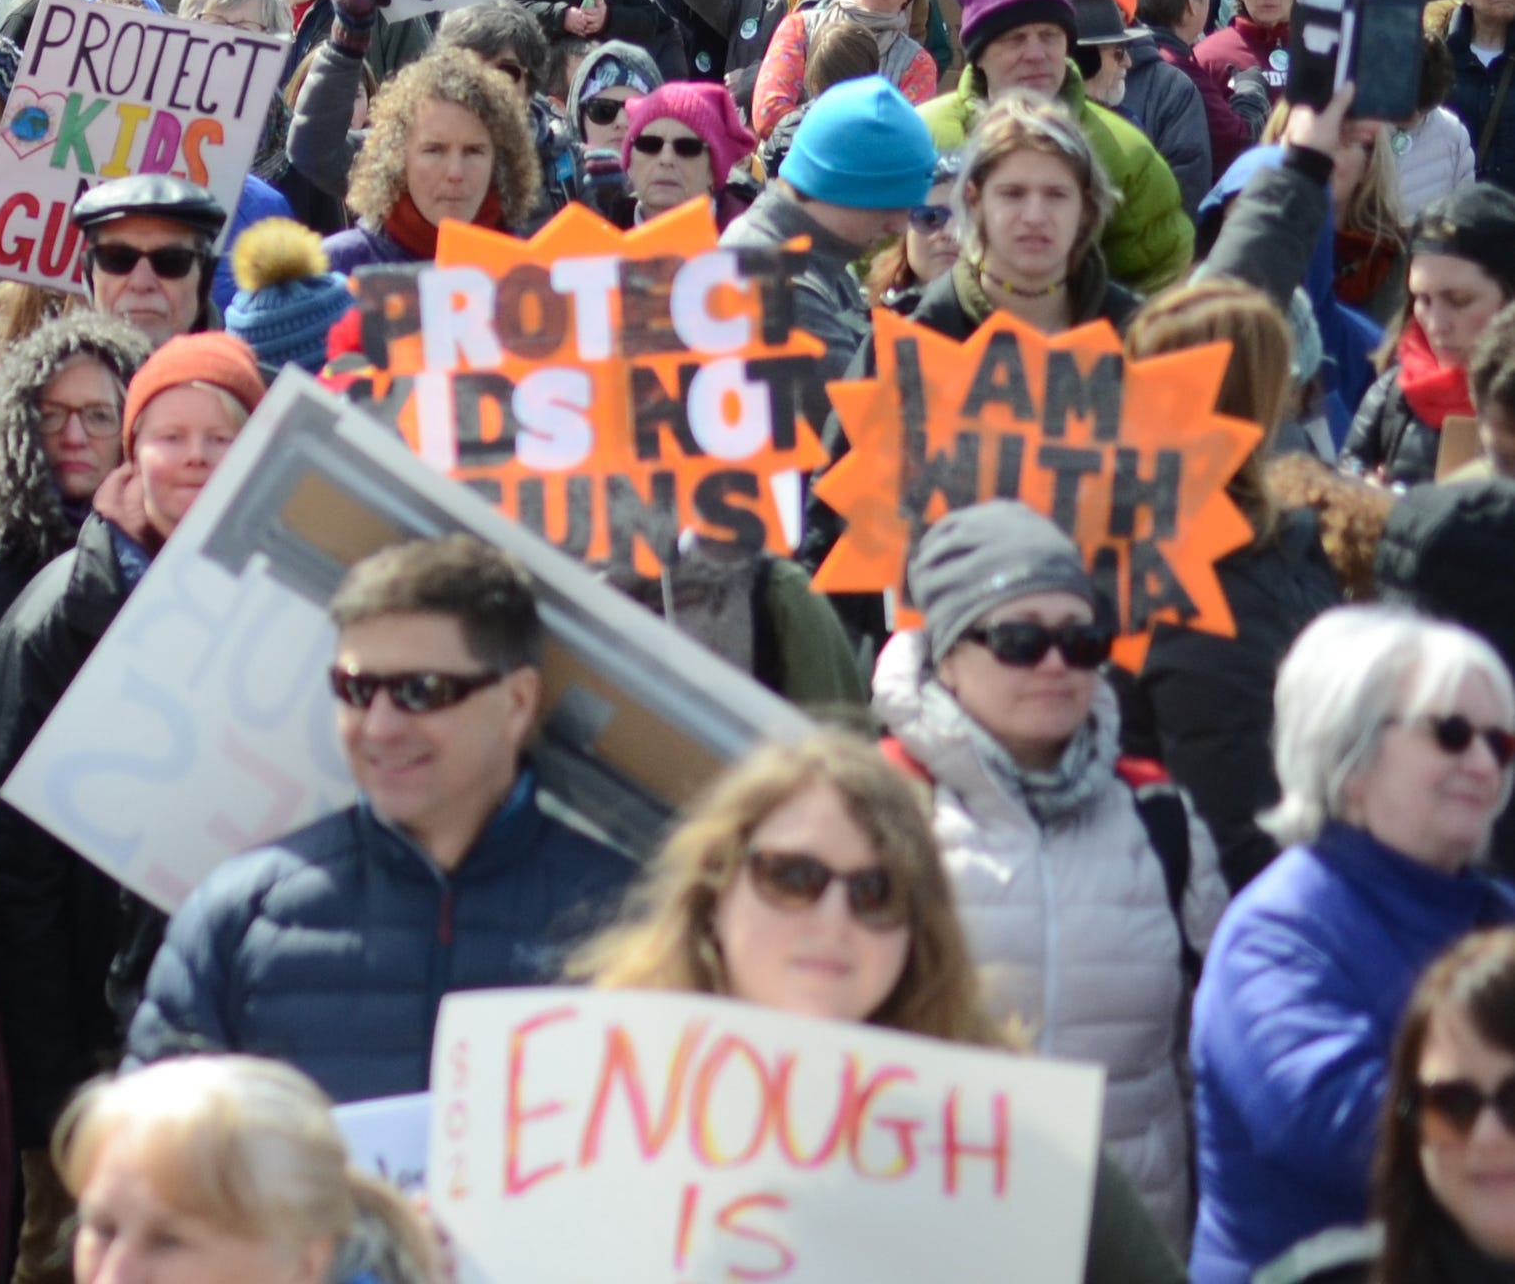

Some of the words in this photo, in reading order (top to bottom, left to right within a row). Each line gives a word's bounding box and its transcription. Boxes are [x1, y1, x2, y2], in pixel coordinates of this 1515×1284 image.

[29, 4, 281, 120] PROTECT
[50, 92, 225, 188] KIDS
[352, 245, 813, 370] PROTECT
[631, 354, 831, 462] NOT
[895, 338, 927, 434] I
[961, 330, 1125, 442] AM
[461, 466, 803, 579] UNS!
[897, 432, 1181, 543] WITH
[502, 1008, 1011, 1199] ENOUGH
[672, 1182, 797, 1282] IS
